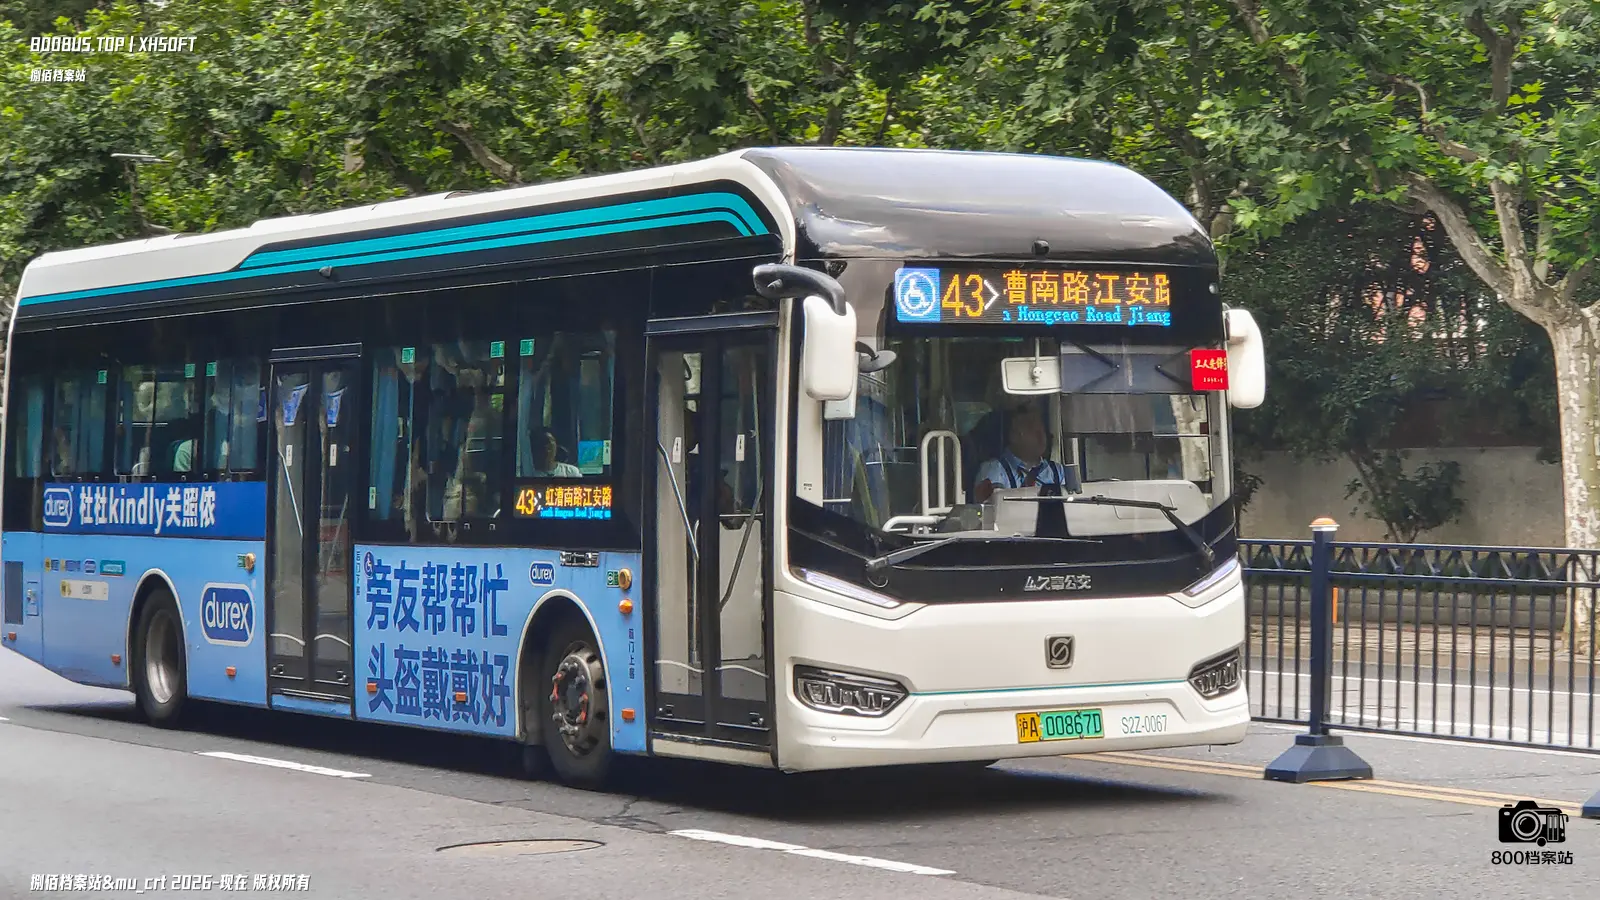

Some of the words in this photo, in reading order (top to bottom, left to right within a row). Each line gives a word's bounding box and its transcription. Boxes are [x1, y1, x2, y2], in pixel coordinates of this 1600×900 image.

[941, 274, 985, 317] 43
[1017, 305, 1080, 325] Hongcao
[1085, 305, 1122, 322] Road
[1127, 305, 1171, 326] Jiang
[45, 494, 70, 518] durex
[79, 485, 216, 534] 杜杜kindly关照侬
[515, 489, 536, 515] 43
[531, 564, 555, 583] durex
[366, 558, 509, 638] 旁友帮帮忙
[205, 592, 250, 636] durex
[366, 642, 511, 727] 头盔戴戴好
[1045, 713, 1102, 736] 00867D
[1121, 714, 1168, 735] S2Z-0067
